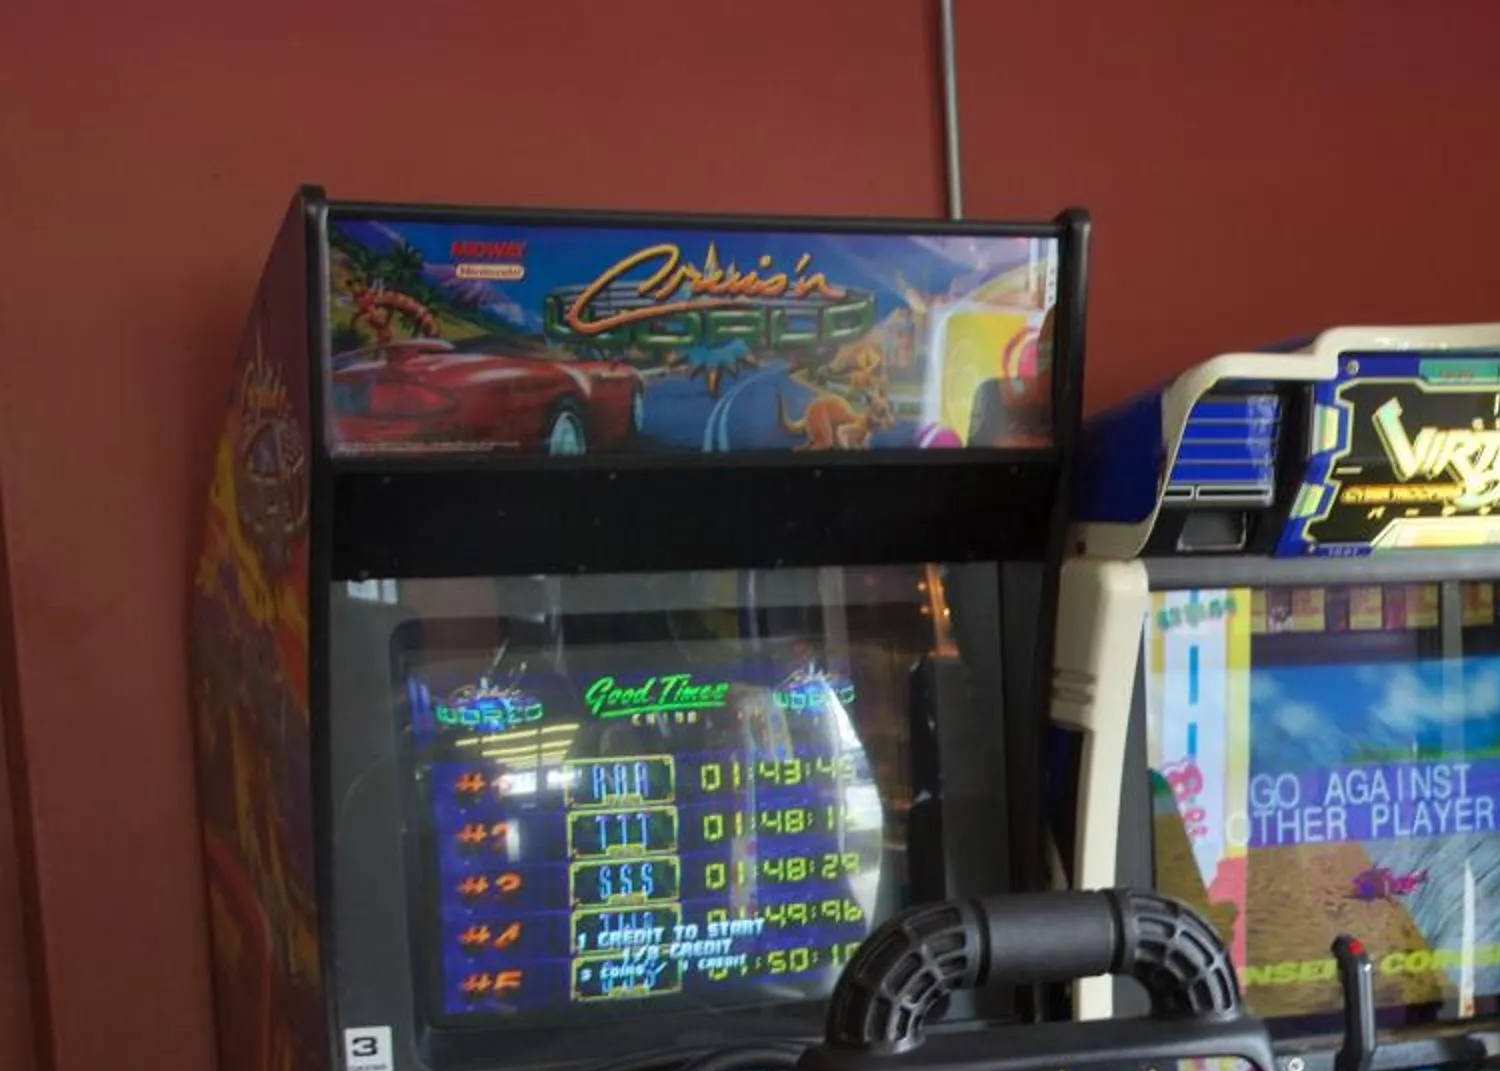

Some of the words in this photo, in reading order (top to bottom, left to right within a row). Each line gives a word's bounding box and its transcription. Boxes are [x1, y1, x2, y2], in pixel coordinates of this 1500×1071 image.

[585, 676, 657, 715] Good
[658, 673, 730, 704] Times
[1250, 772, 1299, 811] GO
[1323, 764, 1471, 806] AGAINST
[1225, 807, 1348, 847] OTHER
[352, 1036, 378, 1057] 3
